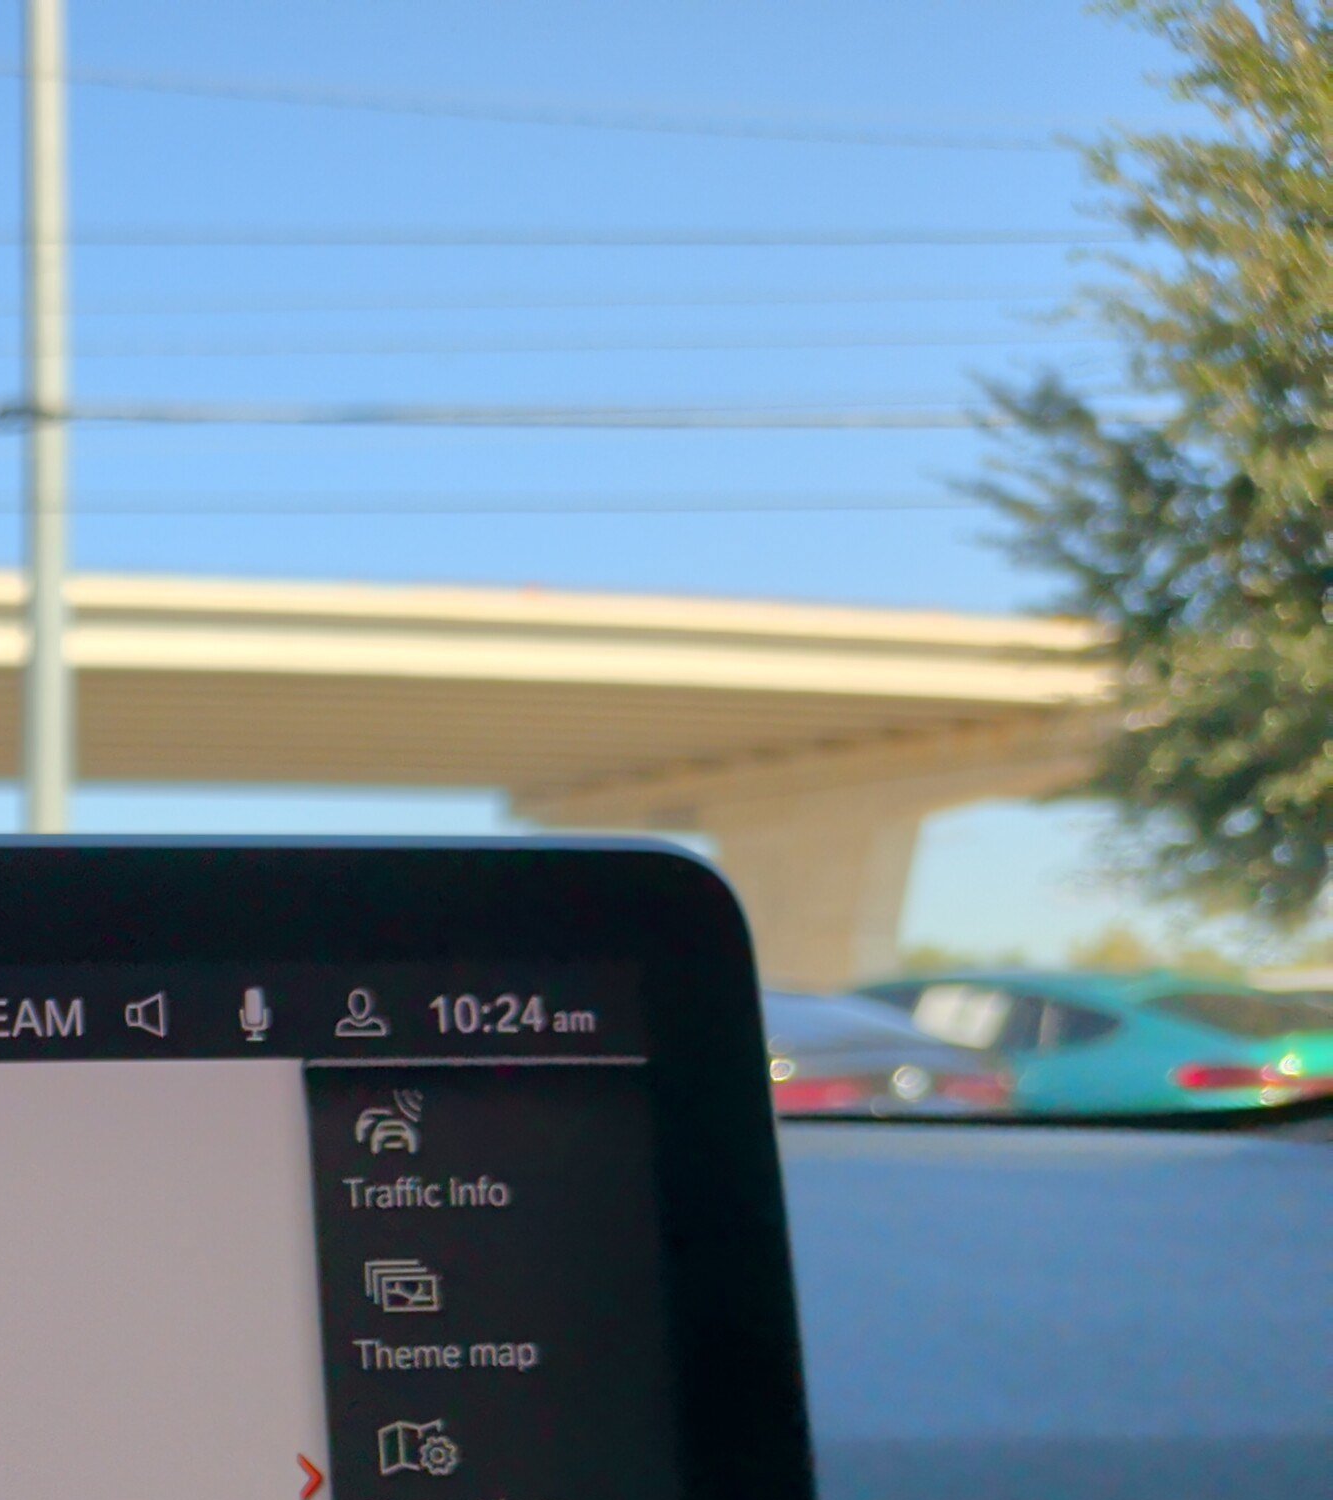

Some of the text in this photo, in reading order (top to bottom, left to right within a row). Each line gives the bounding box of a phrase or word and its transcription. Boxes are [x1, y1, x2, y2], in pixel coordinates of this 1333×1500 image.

[428, 993, 596, 1034] 10:24 am
[343, 1175, 511, 1209] Traffic Info
[352, 1339, 540, 1372] Theme map
